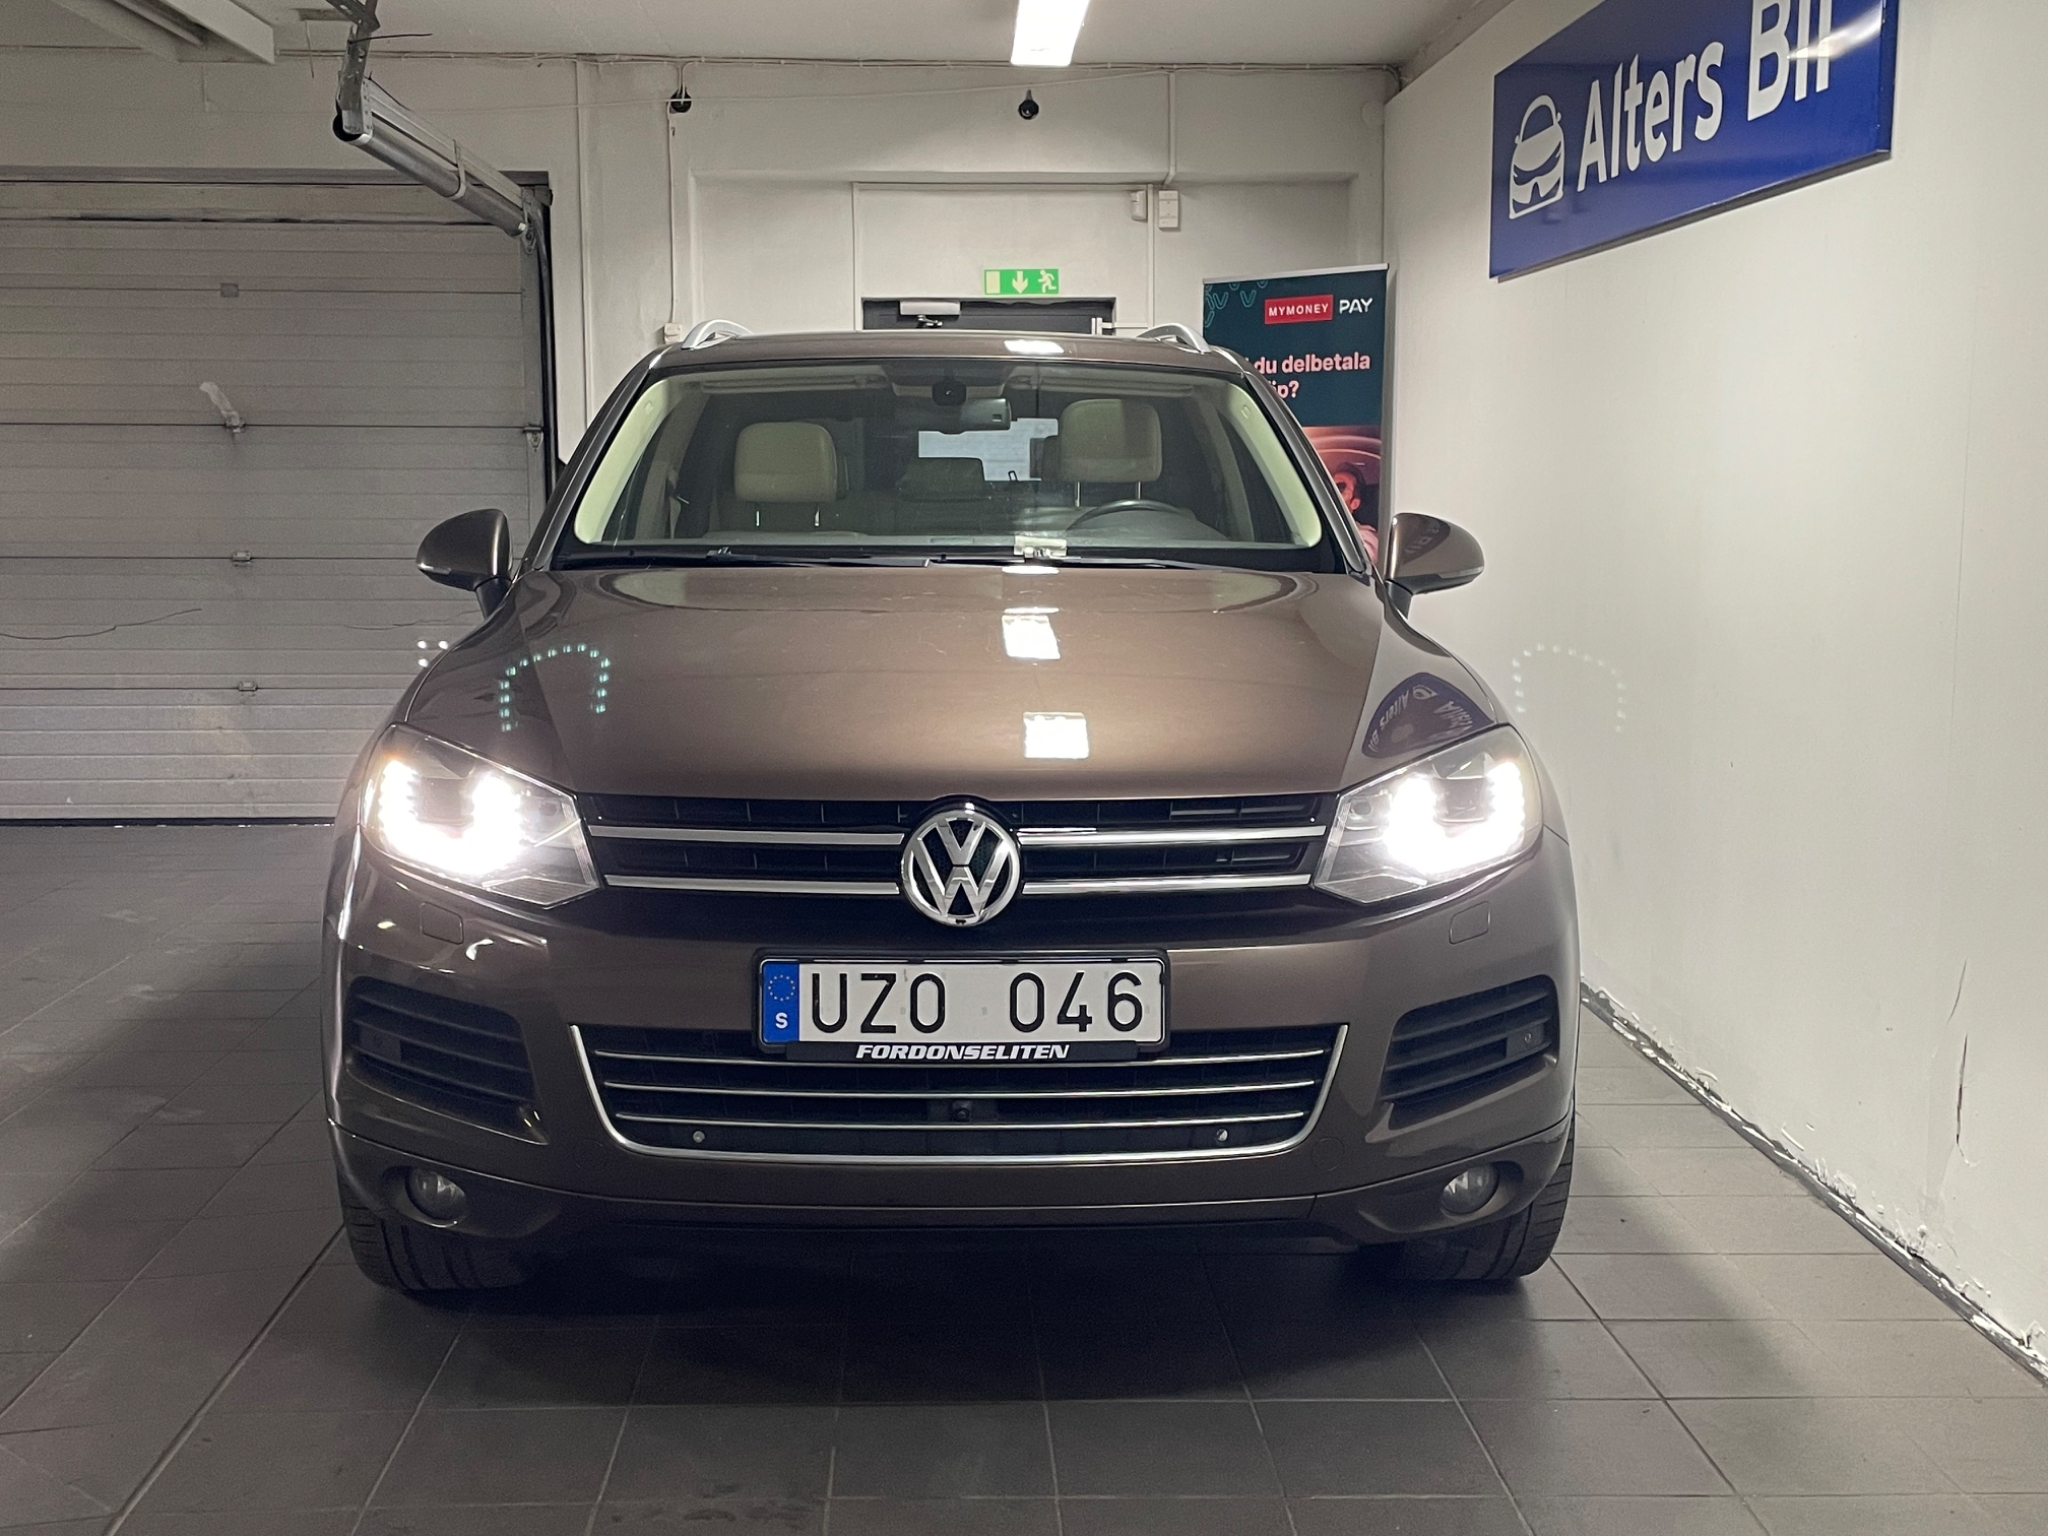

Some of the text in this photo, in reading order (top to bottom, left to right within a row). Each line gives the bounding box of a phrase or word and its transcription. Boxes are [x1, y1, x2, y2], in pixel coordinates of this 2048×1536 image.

[1576, 41, 1725, 193] Alters
[1268, 298, 1373, 317] MYMONEY PAY
[1253, 351, 1371, 374] du delbetala
[904, 811, 1018, 925] VW
[811, 971, 1143, 1034] UZO 046
[774, 1012, 788, 1030] S
[855, 1044, 1070, 1061] FORDONSELITEN
